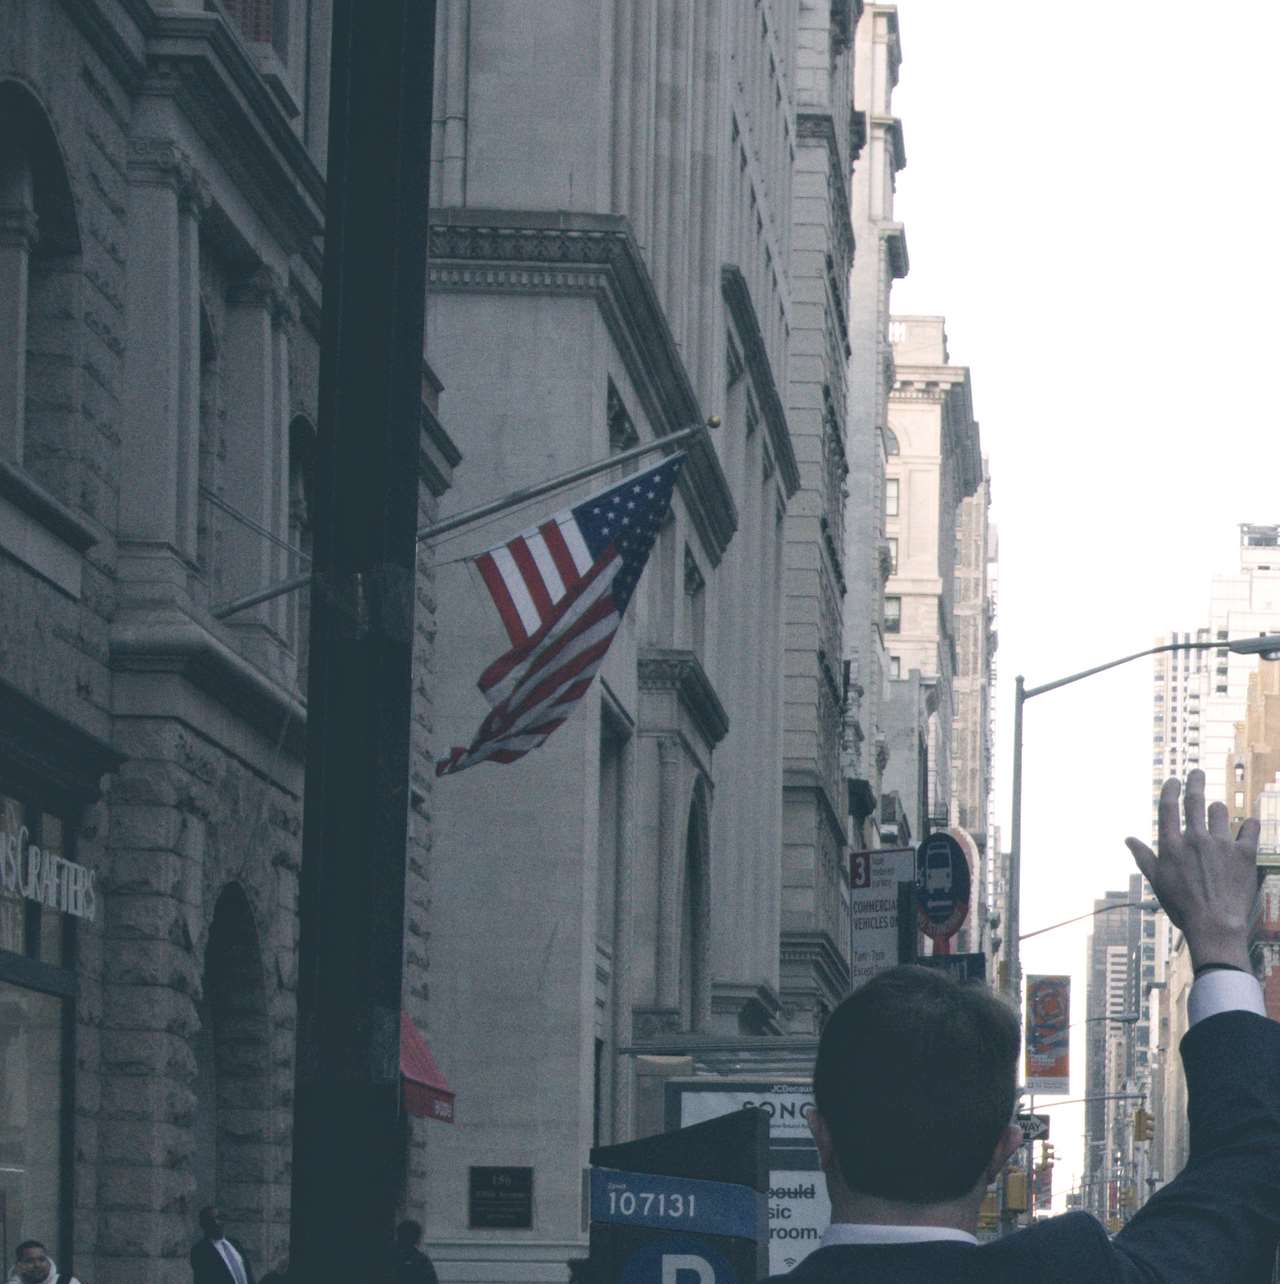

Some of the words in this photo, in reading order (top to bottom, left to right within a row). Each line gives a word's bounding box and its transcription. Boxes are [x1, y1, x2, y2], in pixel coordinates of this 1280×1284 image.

[855, 857, 865, 886] 3
[1018, 1121, 1041, 1133] WAY
[609, 1191, 696, 1217] 107131
[770, 1227, 822, 1240] room.
